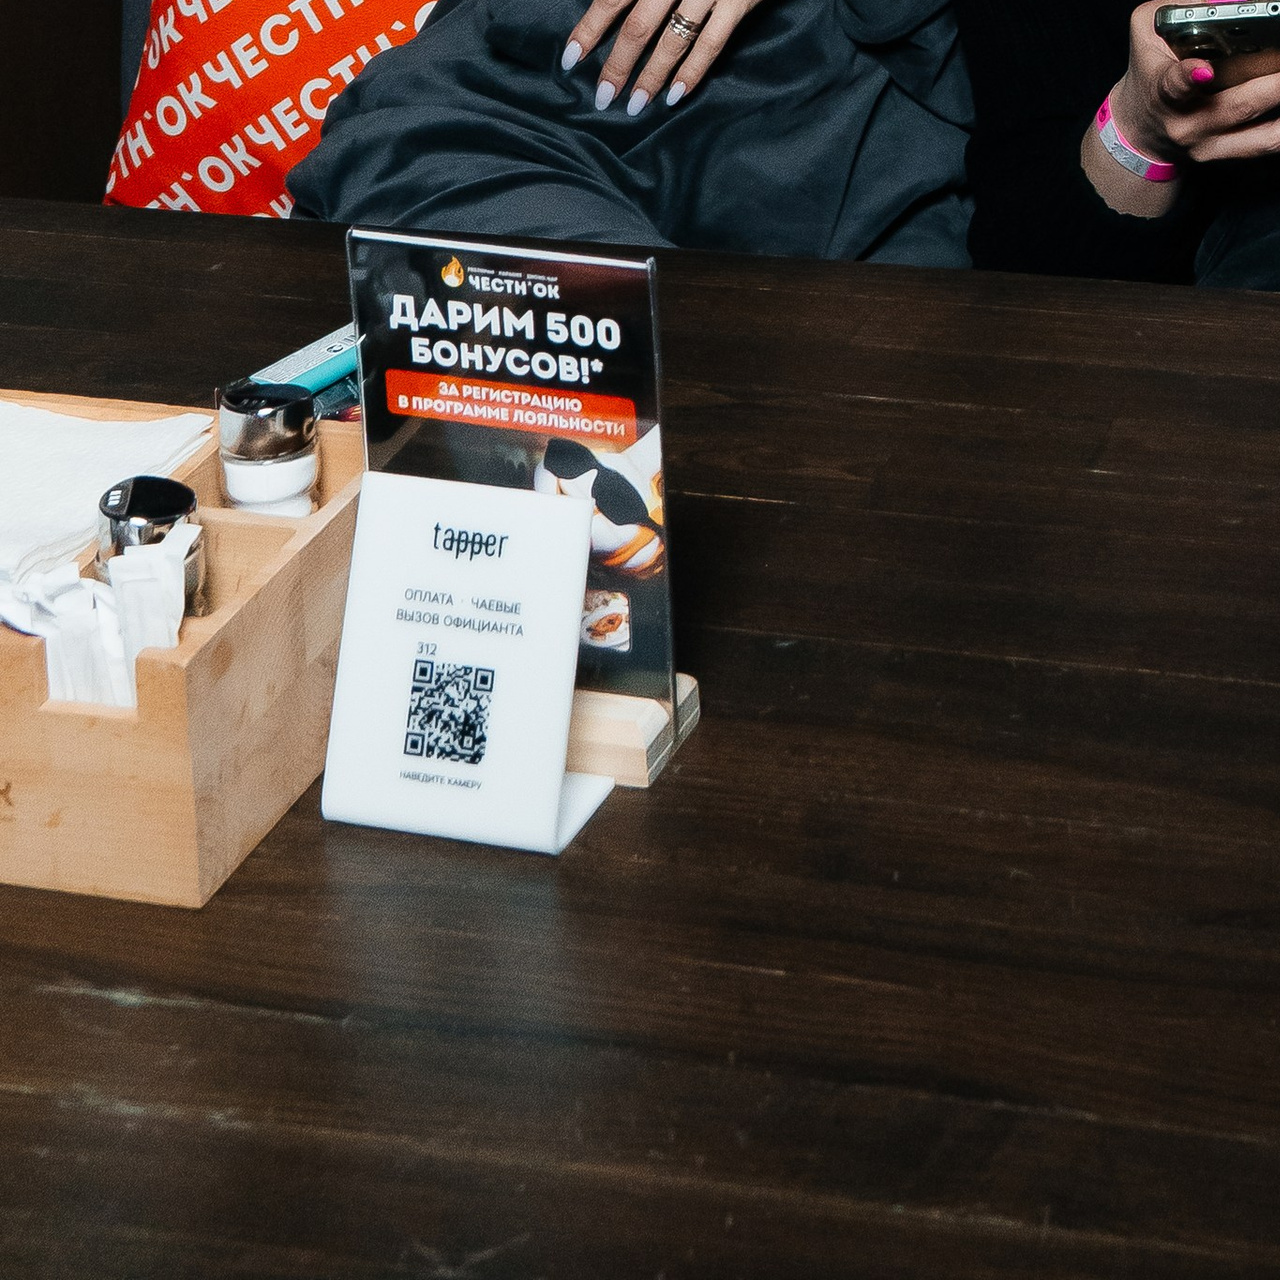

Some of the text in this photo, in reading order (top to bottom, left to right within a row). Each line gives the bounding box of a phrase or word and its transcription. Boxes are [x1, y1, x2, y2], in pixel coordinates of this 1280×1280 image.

[389, 294, 621, 351] ДАРИМ 500
[438, 382, 583, 413] ЗА РЕГИСТРАЦИЮ
[397, 396, 625, 437] В ПРОГРАММЕ ЛОЯЛЬНОСТИ
[433, 522, 508, 561] tapper
[404, 588, 521, 615] ОПЛАТА ЧАЕВЫЕ
[396, 608, 524, 637] ВЫЗОВ ОФИЦИАНТА
[417, 642, 438, 656] 312
